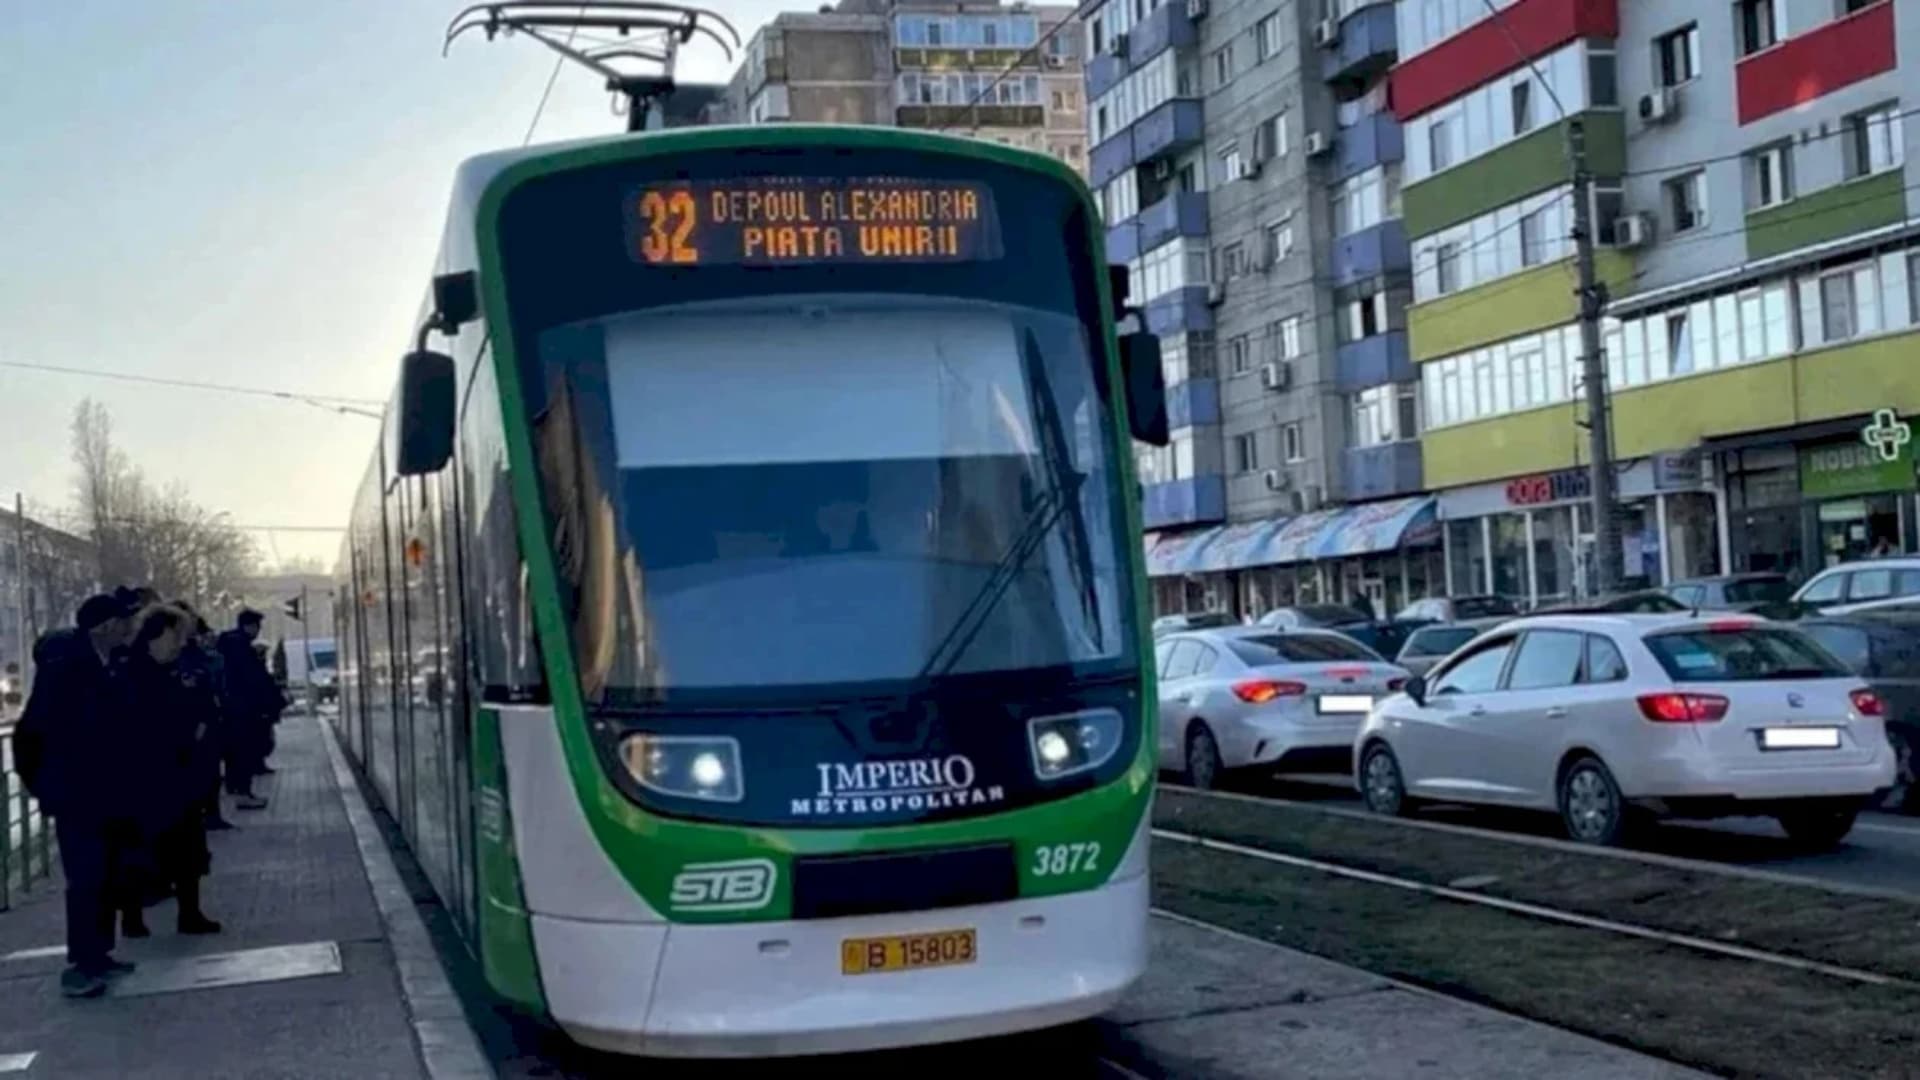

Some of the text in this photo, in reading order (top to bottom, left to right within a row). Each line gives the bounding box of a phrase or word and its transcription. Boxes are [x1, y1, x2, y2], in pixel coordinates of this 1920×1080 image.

[712, 189, 979, 223] DEPOUL ALEXANDRIA
[639, 190, 698, 264] 32
[744, 226, 843, 258] PIATA
[816, 754, 975, 797] IMPERIO
[790, 785, 1005, 816] METROPOLITAN
[1031, 841, 1101, 876] 3872
[671, 862, 771, 908] STB
[868, 932, 973, 969] B 15803
